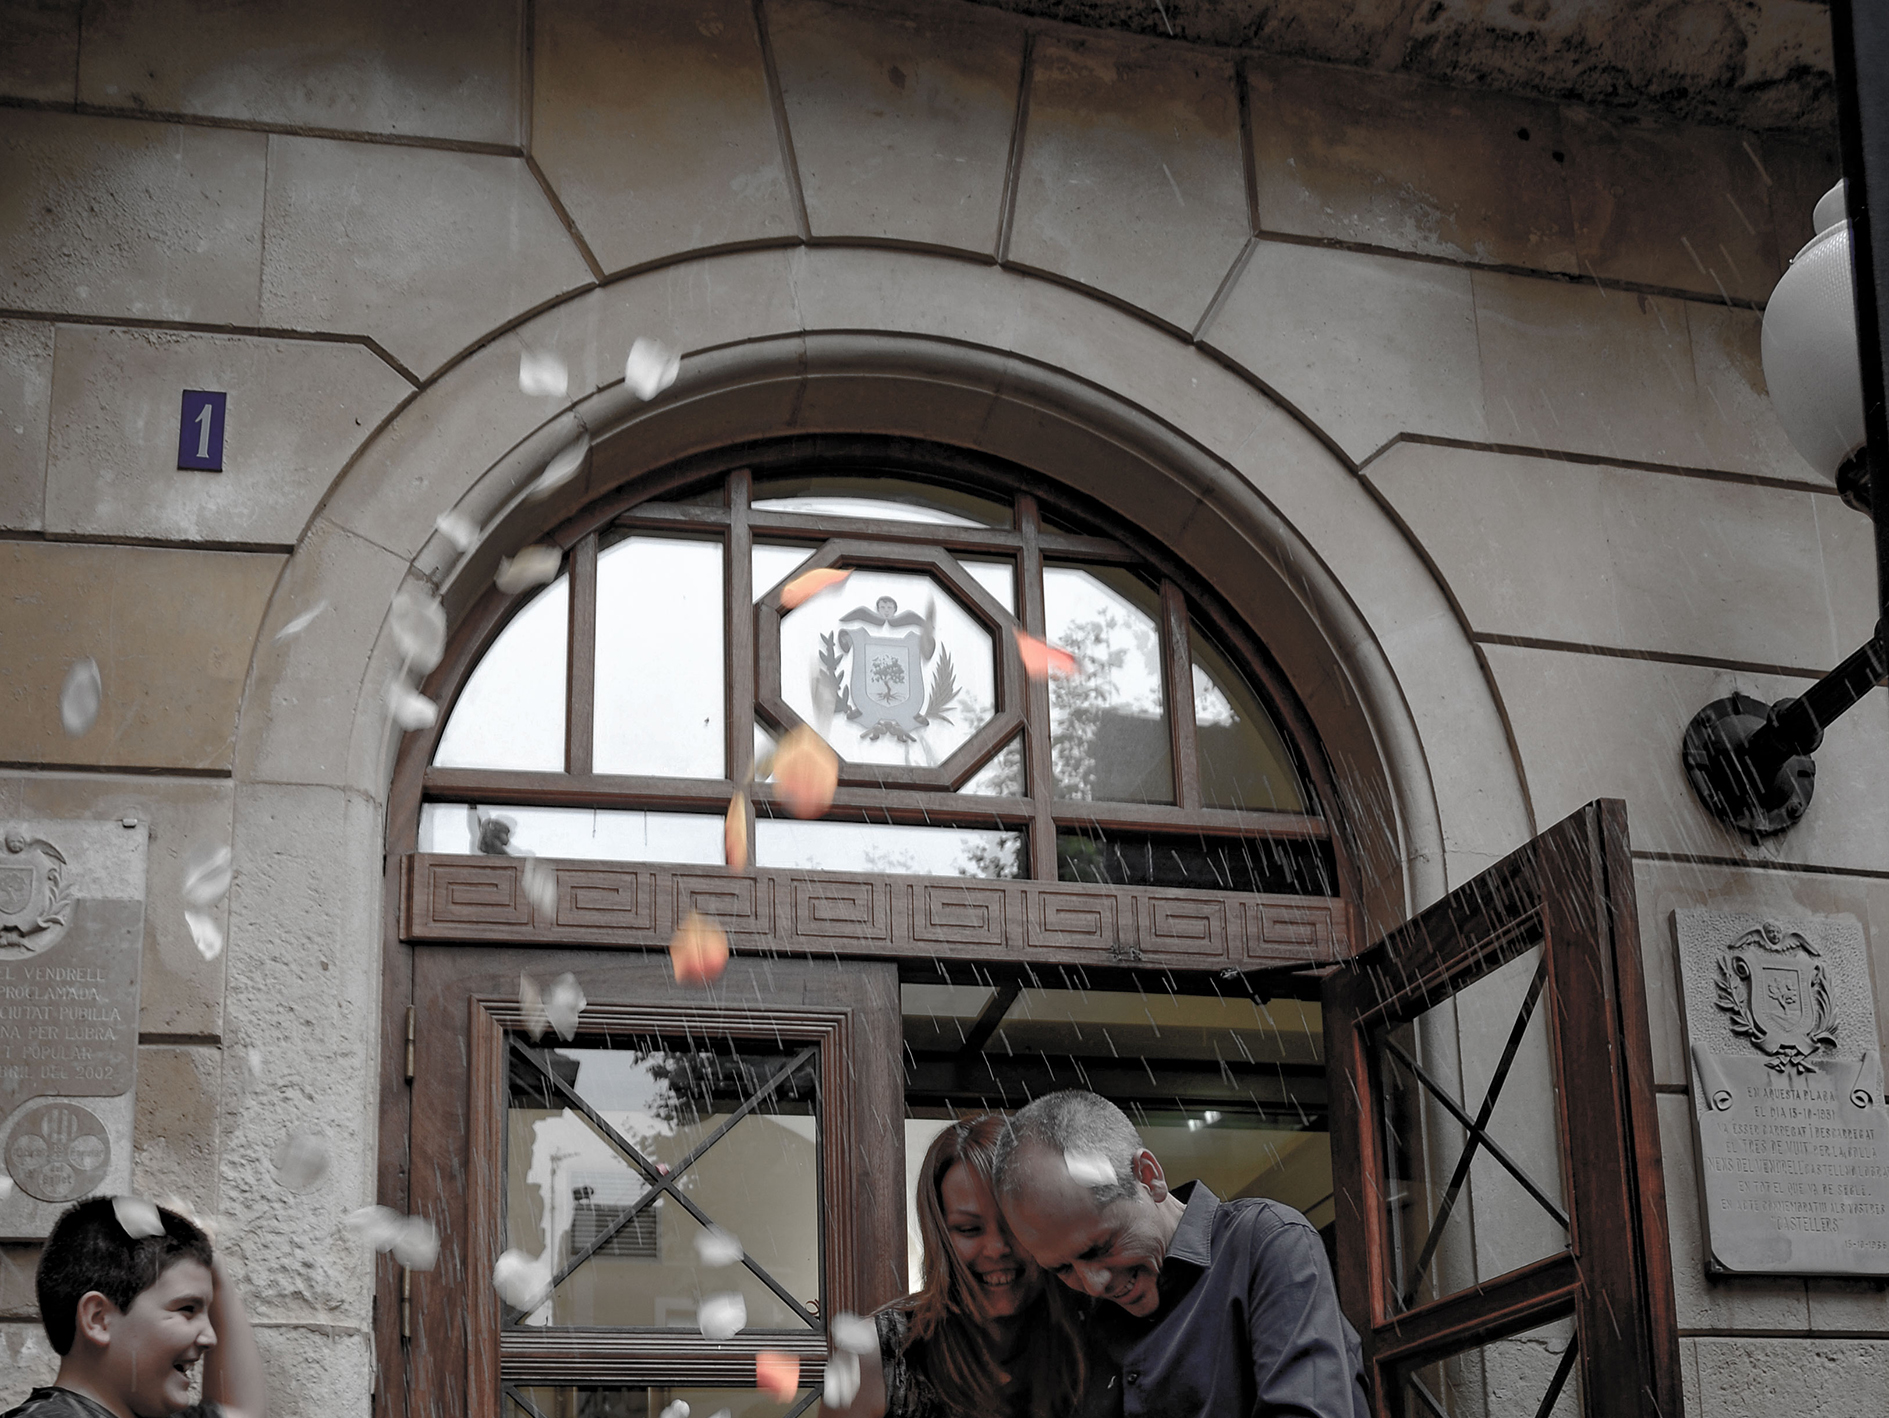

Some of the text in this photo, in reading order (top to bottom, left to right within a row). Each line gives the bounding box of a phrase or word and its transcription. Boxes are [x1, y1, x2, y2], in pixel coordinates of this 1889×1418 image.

[194, 403, 212, 459] 1
[23, 966, 106, 982] VENDRELL
[0, 1006, 121, 1021] CIUTAT PUBILLA
[28, 1026, 59, 1040] PER
[22, 1045, 93, 1060] POPULAR
[41, 1065, 69, 1079] DEL
[75, 1066, 114, 1080] 2002
[1747, 1086, 1759, 1098] EN
[1763, 1087, 1801, 1101] AQUESTA
[1754, 1105, 1766, 1117] EL
[1770, 1106, 1787, 1119] DIA
[1726, 1141, 1737, 1153] EL
[1770, 1139, 1783, 1155] DE
[1736, 1157, 1754, 1173] DEL
[1738, 1180, 1751, 1192] EN
[1753, 1181, 1770, 1193] TOT
[1773, 1182, 1784, 1194] EL
[1787, 1182, 1804, 1196] QUE
[1721, 1198, 1732, 1210] EN
[1830, 1202, 1845, 1214] ALS
